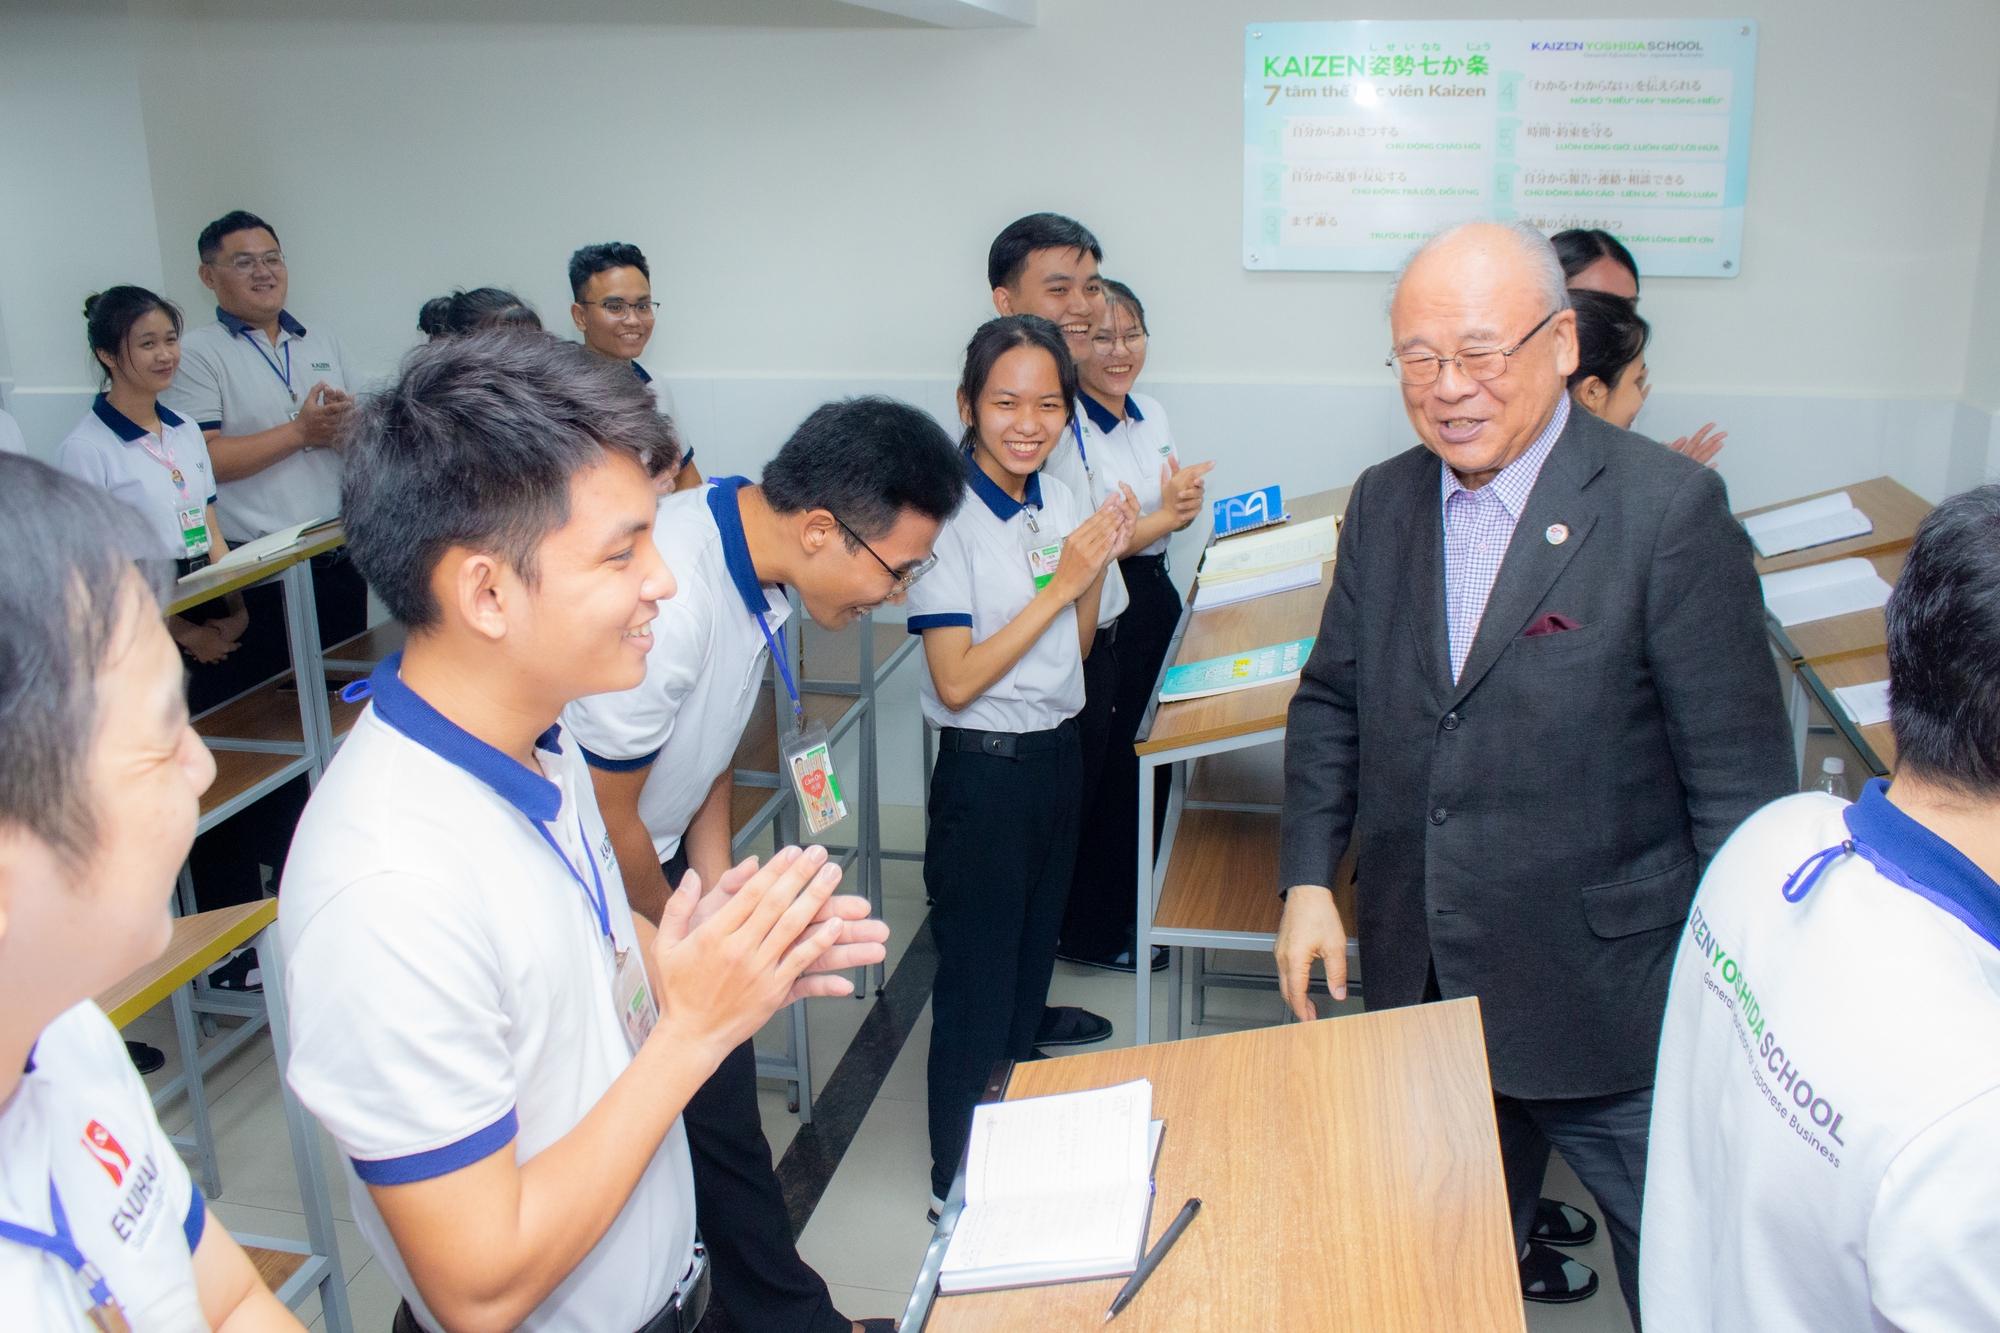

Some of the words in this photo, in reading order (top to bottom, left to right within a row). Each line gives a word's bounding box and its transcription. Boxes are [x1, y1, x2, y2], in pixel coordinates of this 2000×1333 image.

[1531, 41, 1584, 51] KAIZEN
[1586, 41, 1646, 51] YOSHIDA
[1648, 41, 1704, 51] SCHOOL
[1263, 85, 1282, 106] 7
[1285, 84, 1317, 98] tâm
[1322, 82, 1351, 98] thế
[1388, 84, 1424, 98] viên
[1429, 84, 1487, 98] Kaizen
[1293, 126, 1399, 138] 自分からあいさつする
[1266, 174, 1278, 192] 2
[1265, 217, 1277, 235] 3
[1291, 216, 1338, 228] まず謝る
[1712, 942, 1765, 1044] YOSHIDA
[1760, 1031, 1845, 1147] SCHOOL
[1704, 971, 1736, 1012] General
[1752, 1063, 1788, 1119] Japanese
[1788, 1113, 1841, 1169] Business
